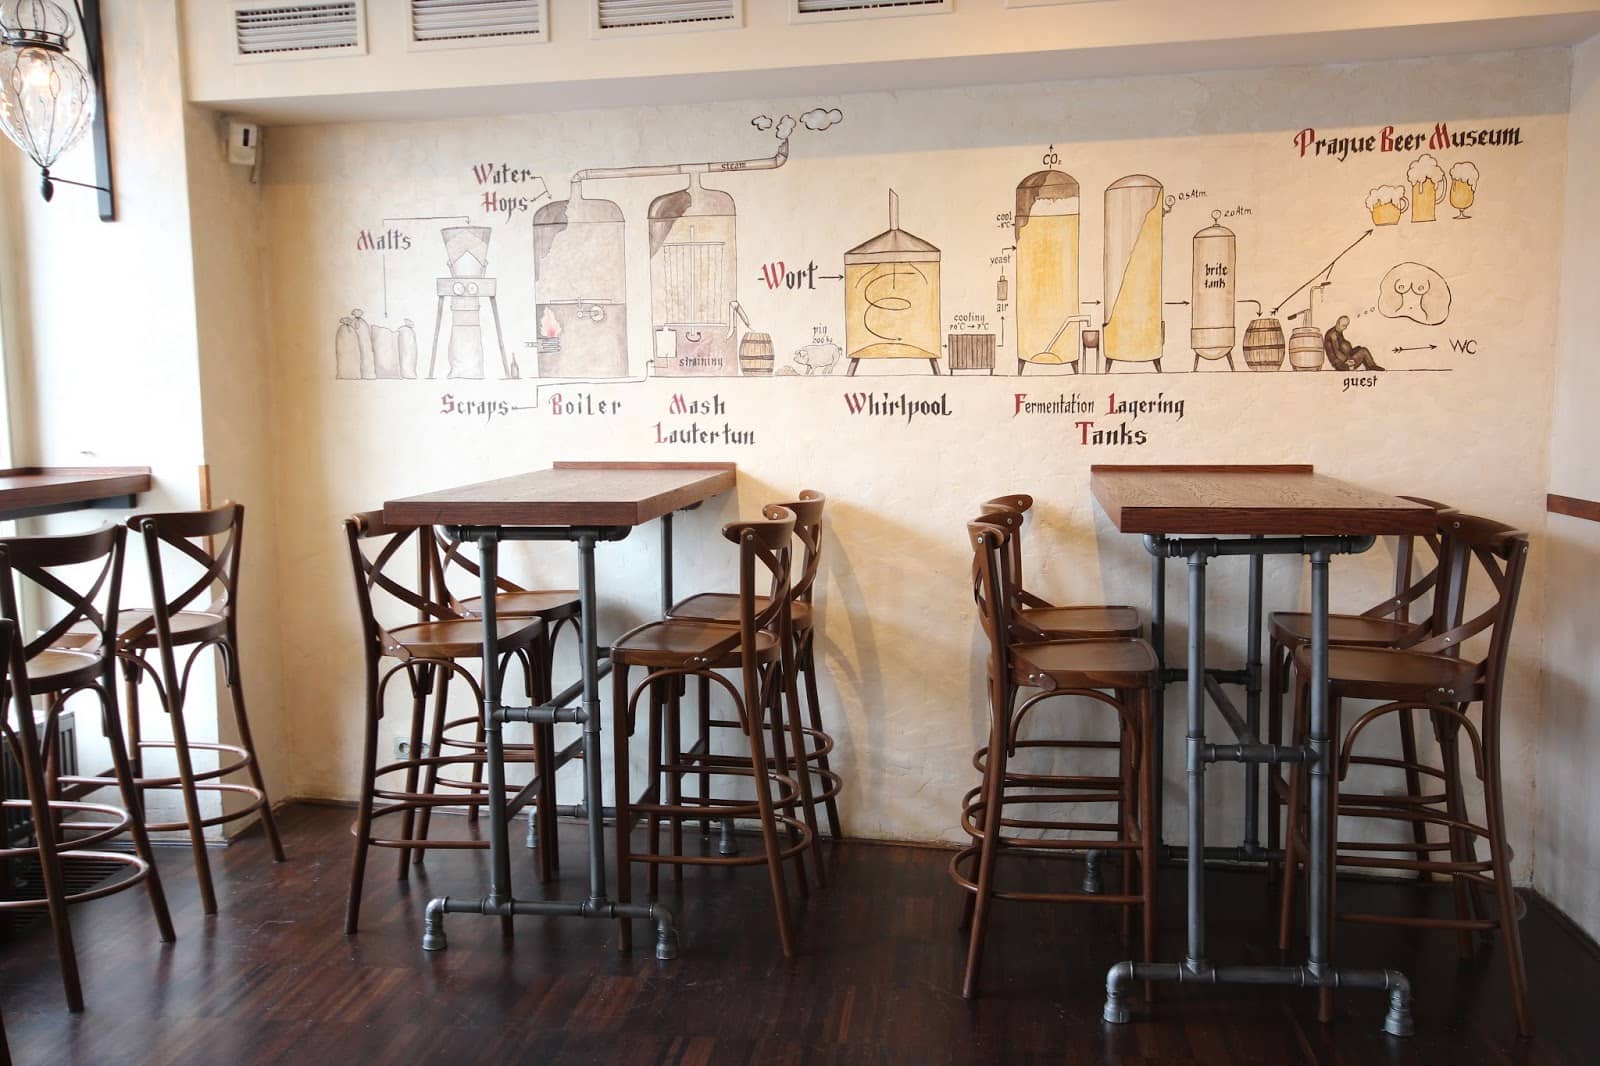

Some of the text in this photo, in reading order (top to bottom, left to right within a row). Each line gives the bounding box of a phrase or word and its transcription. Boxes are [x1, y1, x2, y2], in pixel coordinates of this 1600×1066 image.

[1293, 121, 1523, 162] Prague Beer Museum
[472, 163, 532, 185] Water
[481, 191, 529, 224] Hops
[996, 210, 1012, 221] cool
[356, 229, 412, 251] Malts
[990, 253, 1011, 266] yeast
[1205, 263, 1228, 276] brite
[762, 260, 818, 290] Wort
[1204, 278, 1226, 289] tank
[953, 312, 986, 324] cooling
[996, 303, 1009, 313] air
[812, 322, 828, 337] pig
[1449, 339, 1477, 355] WC
[679, 356, 723, 370] straining
[1342, 376, 1378, 392] guest
[440, 393, 509, 424] Scraps
[549, 392, 623, 416] Boiler
[669, 392, 726, 416] Mash
[843, 391, 953, 425] Whirlpool
[1013, 393, 1095, 418] Fermentation
[1104, 393, 1185, 421] Lagering
[1074, 421, 1148, 447] Tanks
